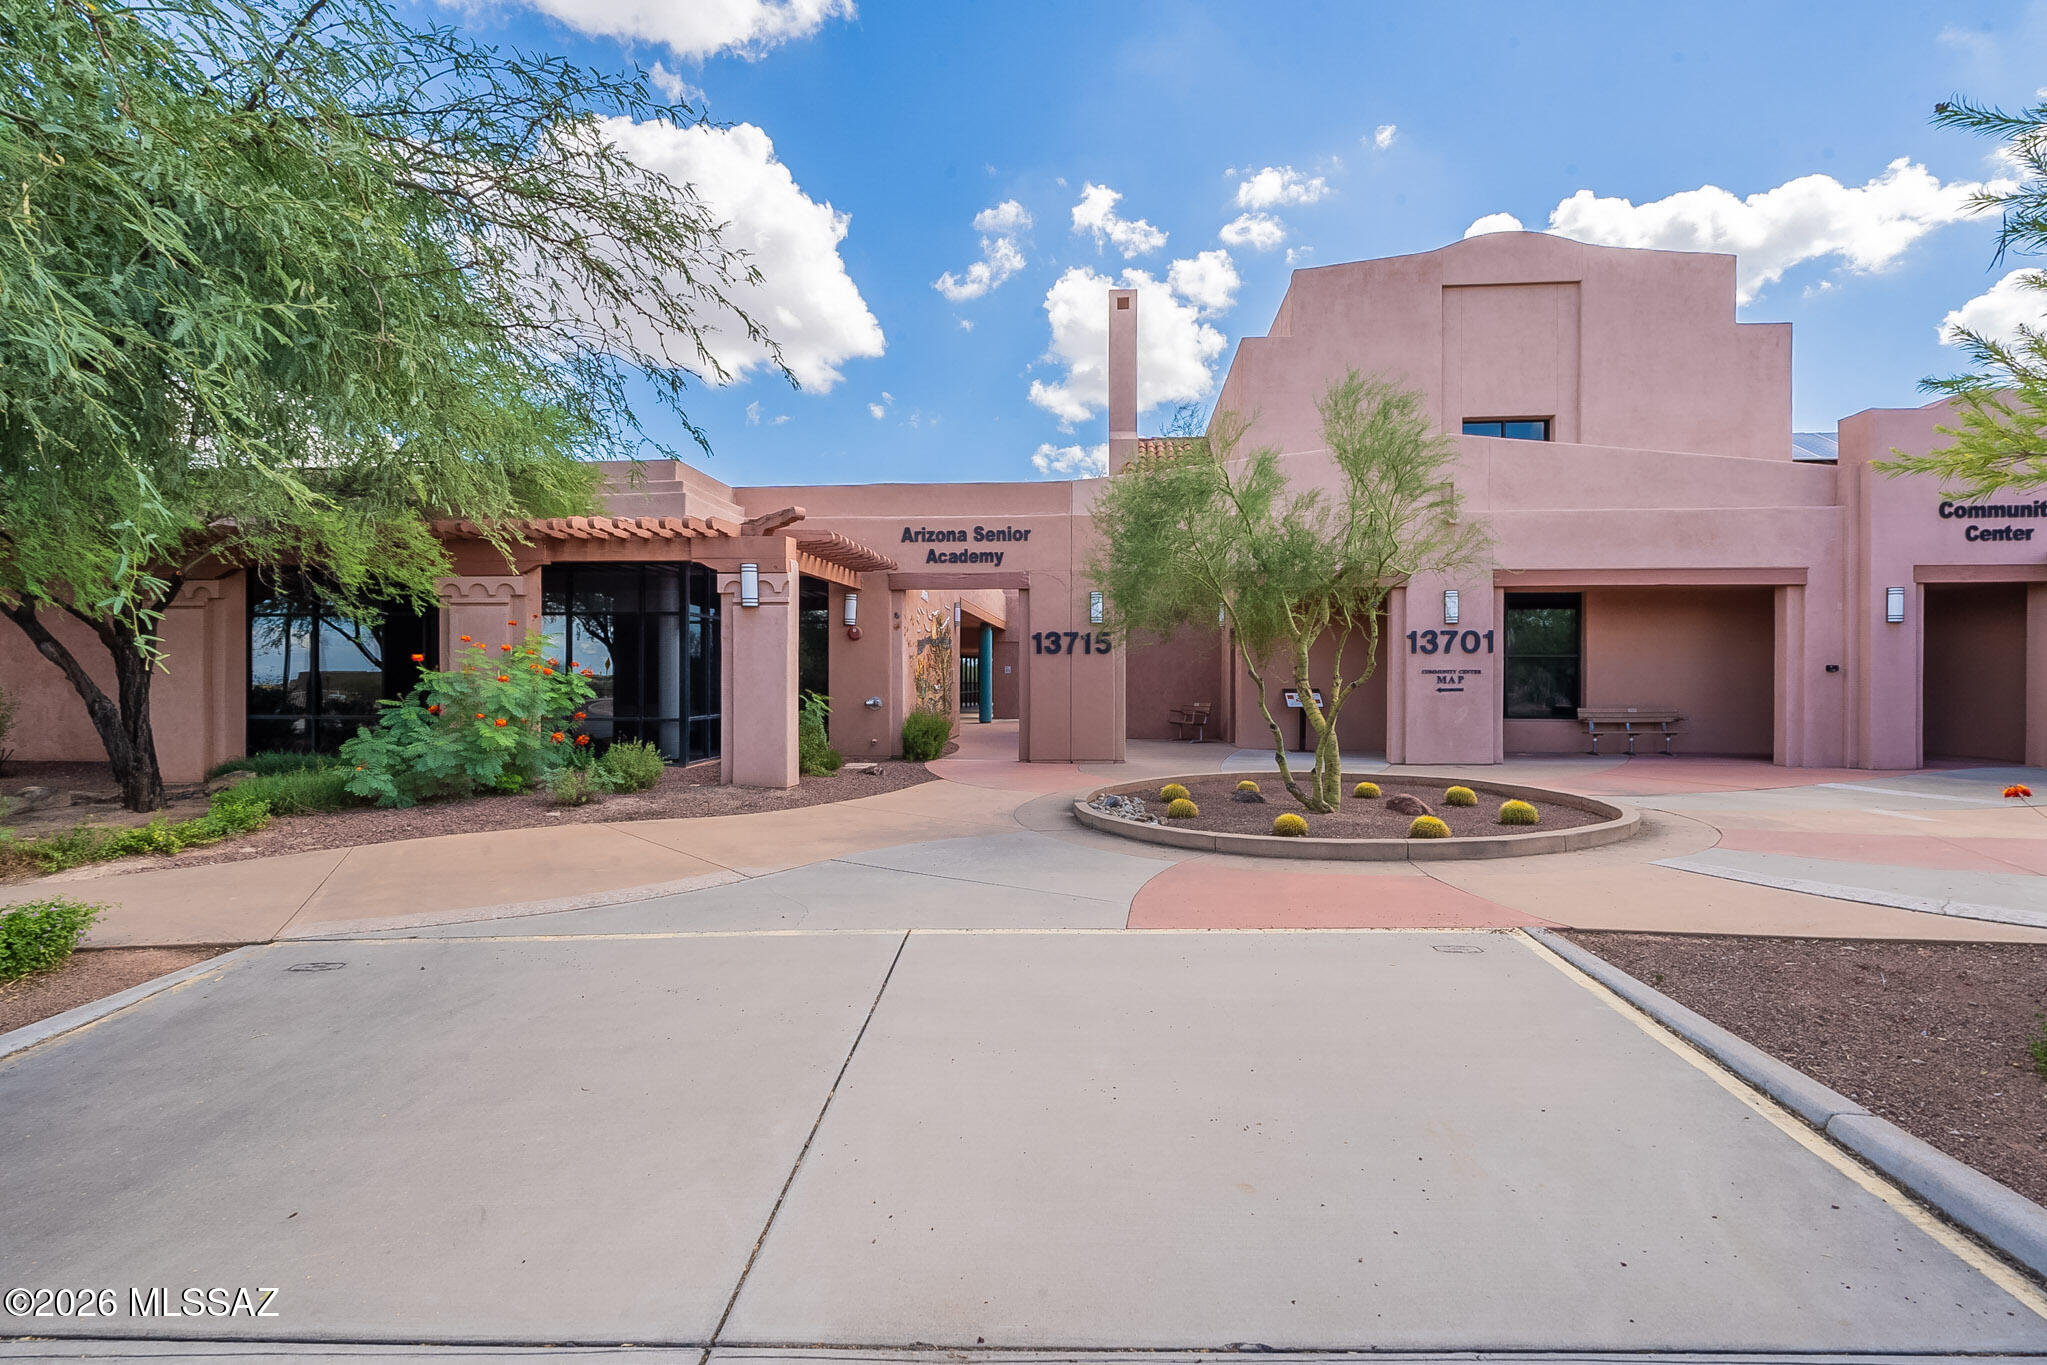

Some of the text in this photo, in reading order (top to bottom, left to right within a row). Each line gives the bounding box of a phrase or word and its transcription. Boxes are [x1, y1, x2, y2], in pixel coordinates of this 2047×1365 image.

[901, 526, 1031, 543] Arizona Senior
[1965, 525, 2035, 542] Center
[926, 549, 1004, 567] Academy
[1032, 631, 1112, 654] 13715
[1406, 630, 1494, 654] 13701
[1436, 675, 1464, 684] MAP
